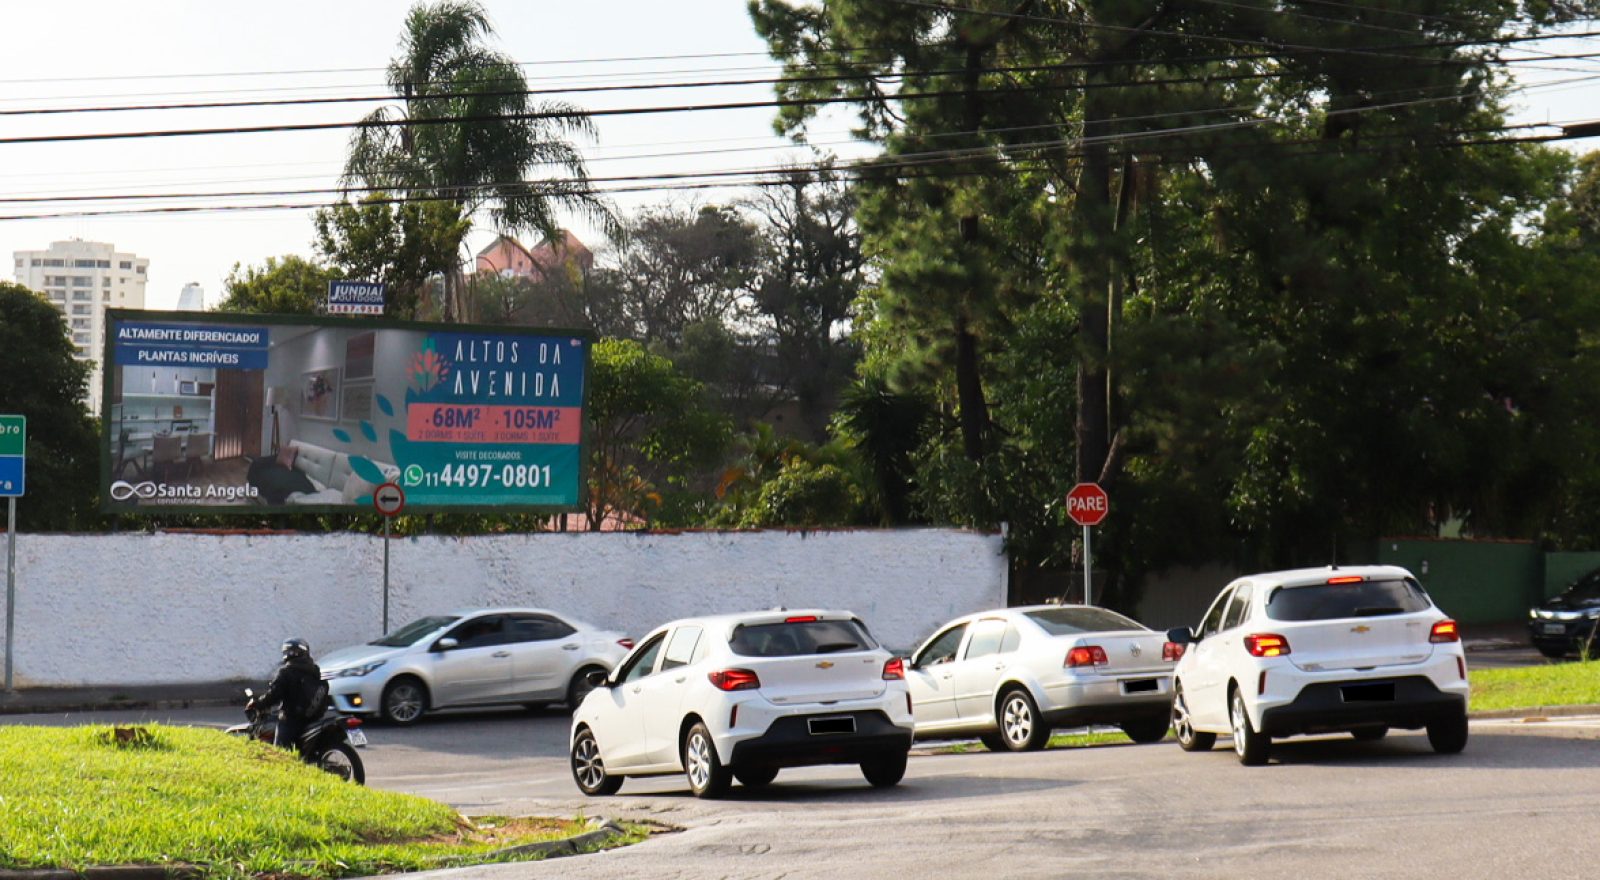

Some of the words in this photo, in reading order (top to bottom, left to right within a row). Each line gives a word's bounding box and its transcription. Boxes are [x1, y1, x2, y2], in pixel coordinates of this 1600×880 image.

[118, 327, 182, 341] ALTAMENTE
[183, 330, 260, 343] DIFERENCIADO!
[138, 350, 187, 362] PLANTAS
[189, 350, 239, 364] INCRÍVEIS
[455, 339, 519, 363] ALTOS
[539, 343, 562, 365] DA
[454, 370, 560, 397] AVENIDA
[455, 450, 477, 459] VISITE
[157, 483, 201, 497] Santa
[206, 482, 258, 500] Angela
[1068, 496, 1105, 511] PARE
